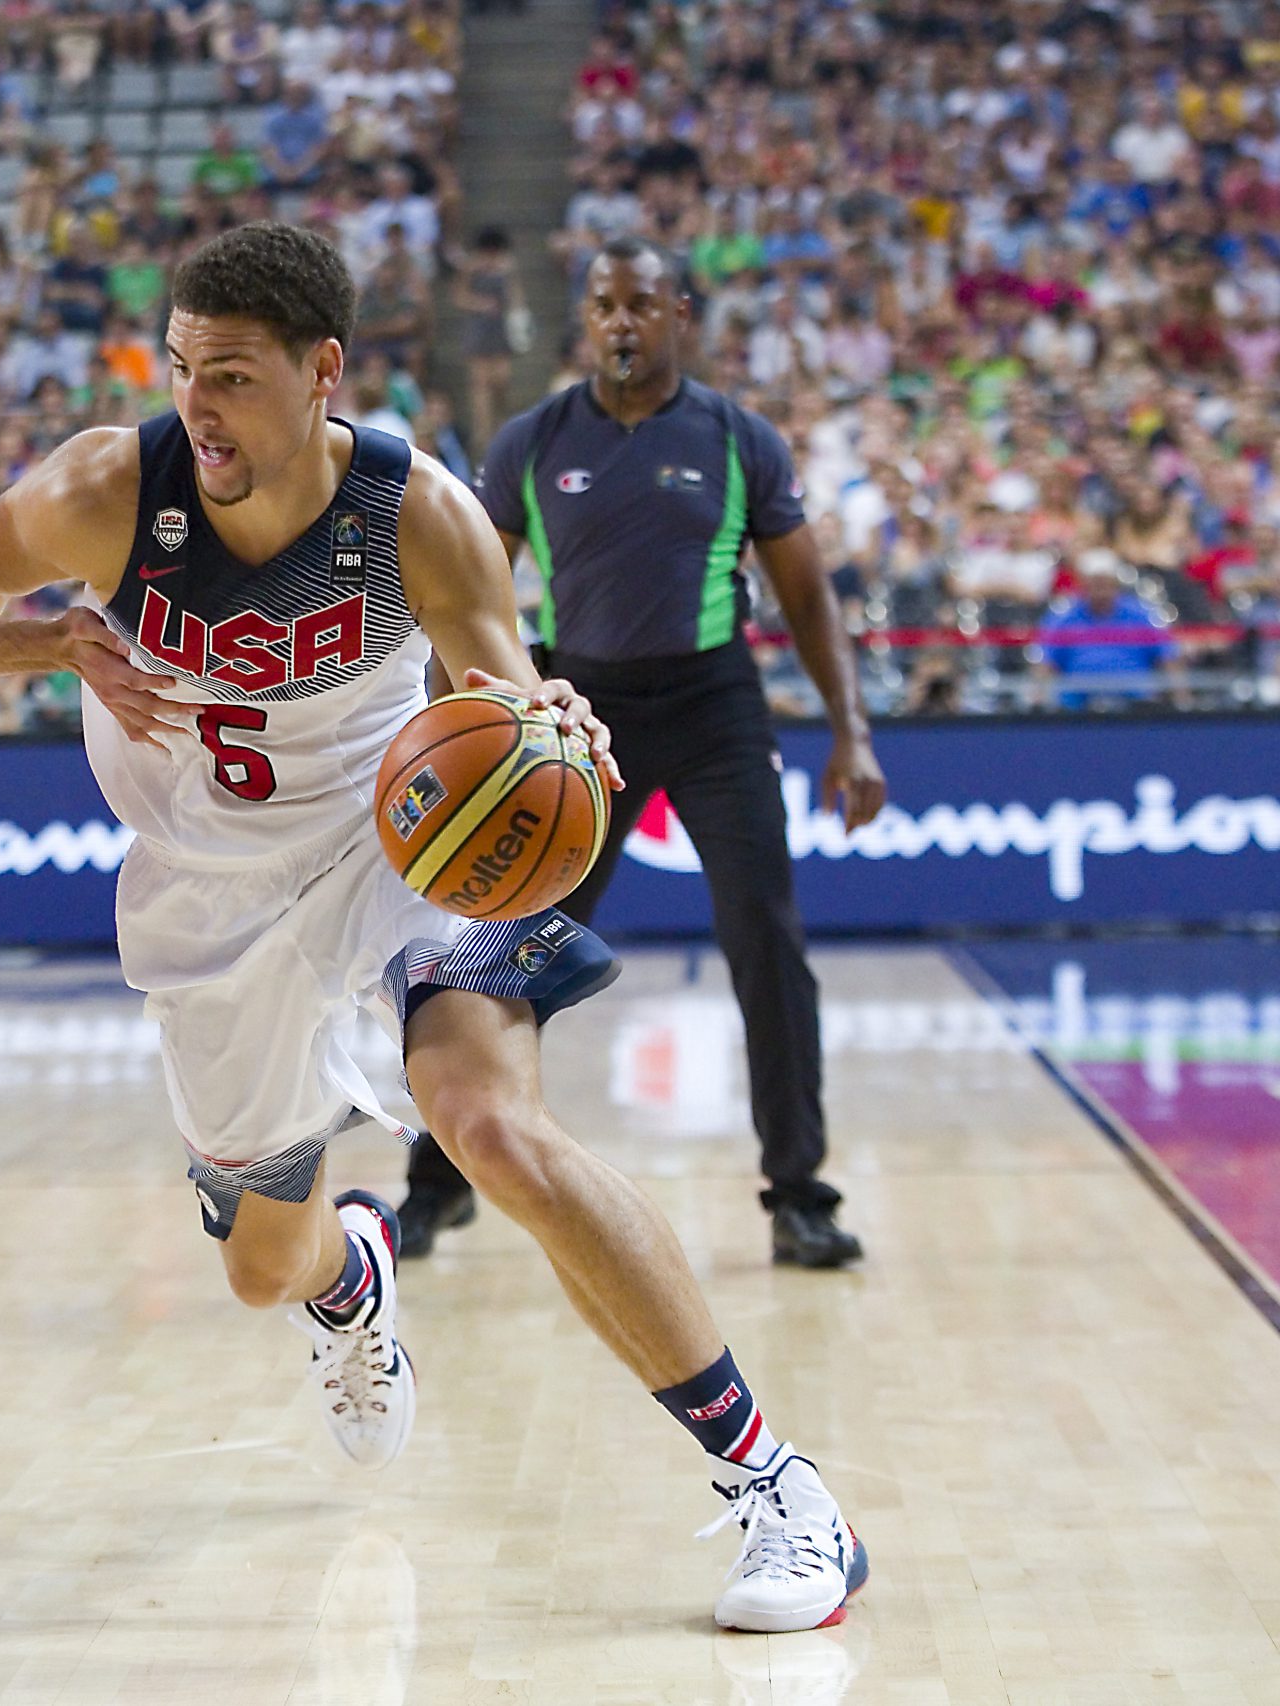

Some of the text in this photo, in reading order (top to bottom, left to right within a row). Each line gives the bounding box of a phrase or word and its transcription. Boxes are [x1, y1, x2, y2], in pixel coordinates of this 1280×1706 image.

[335, 553, 362, 567] FIBA
[137, 584, 367, 693] USA
[441, 808, 541, 910] molten
[540, 919, 565, 939] FIBA
[686, 1381, 743, 1421] USA
